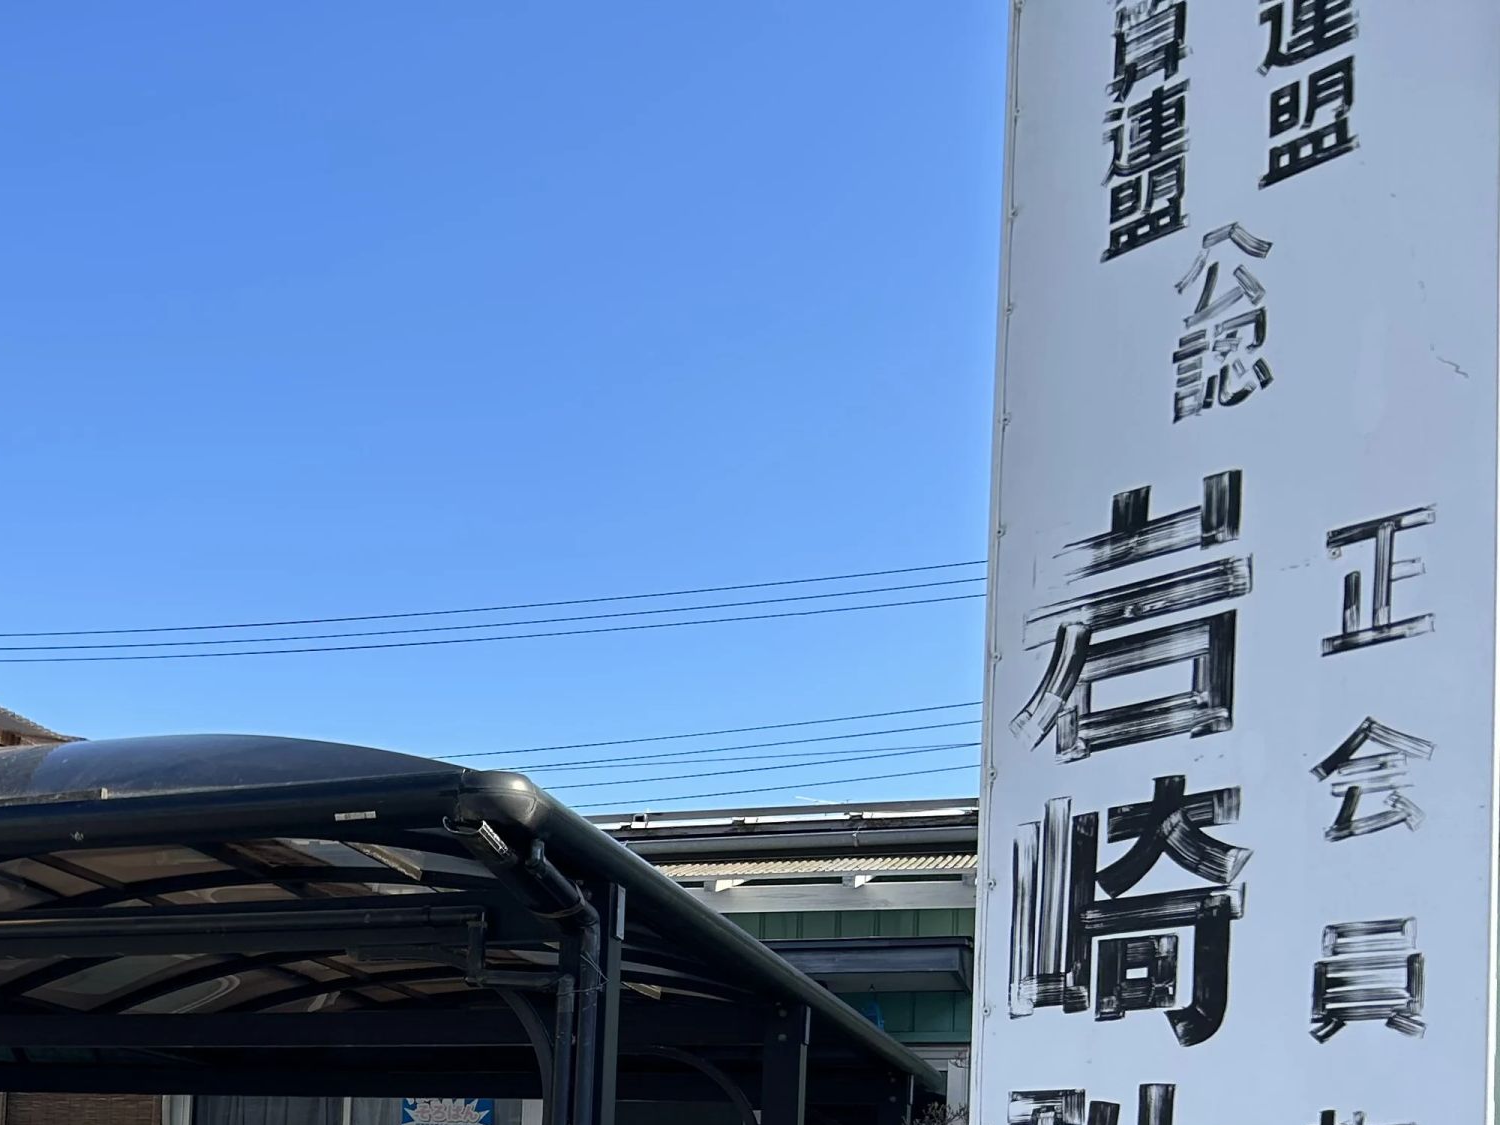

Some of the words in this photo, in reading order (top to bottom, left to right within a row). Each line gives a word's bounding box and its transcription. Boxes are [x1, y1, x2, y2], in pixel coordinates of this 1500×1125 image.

[1172, 222, 1273, 424] 公認
[414, 1103, 480, 1123] そろばん
